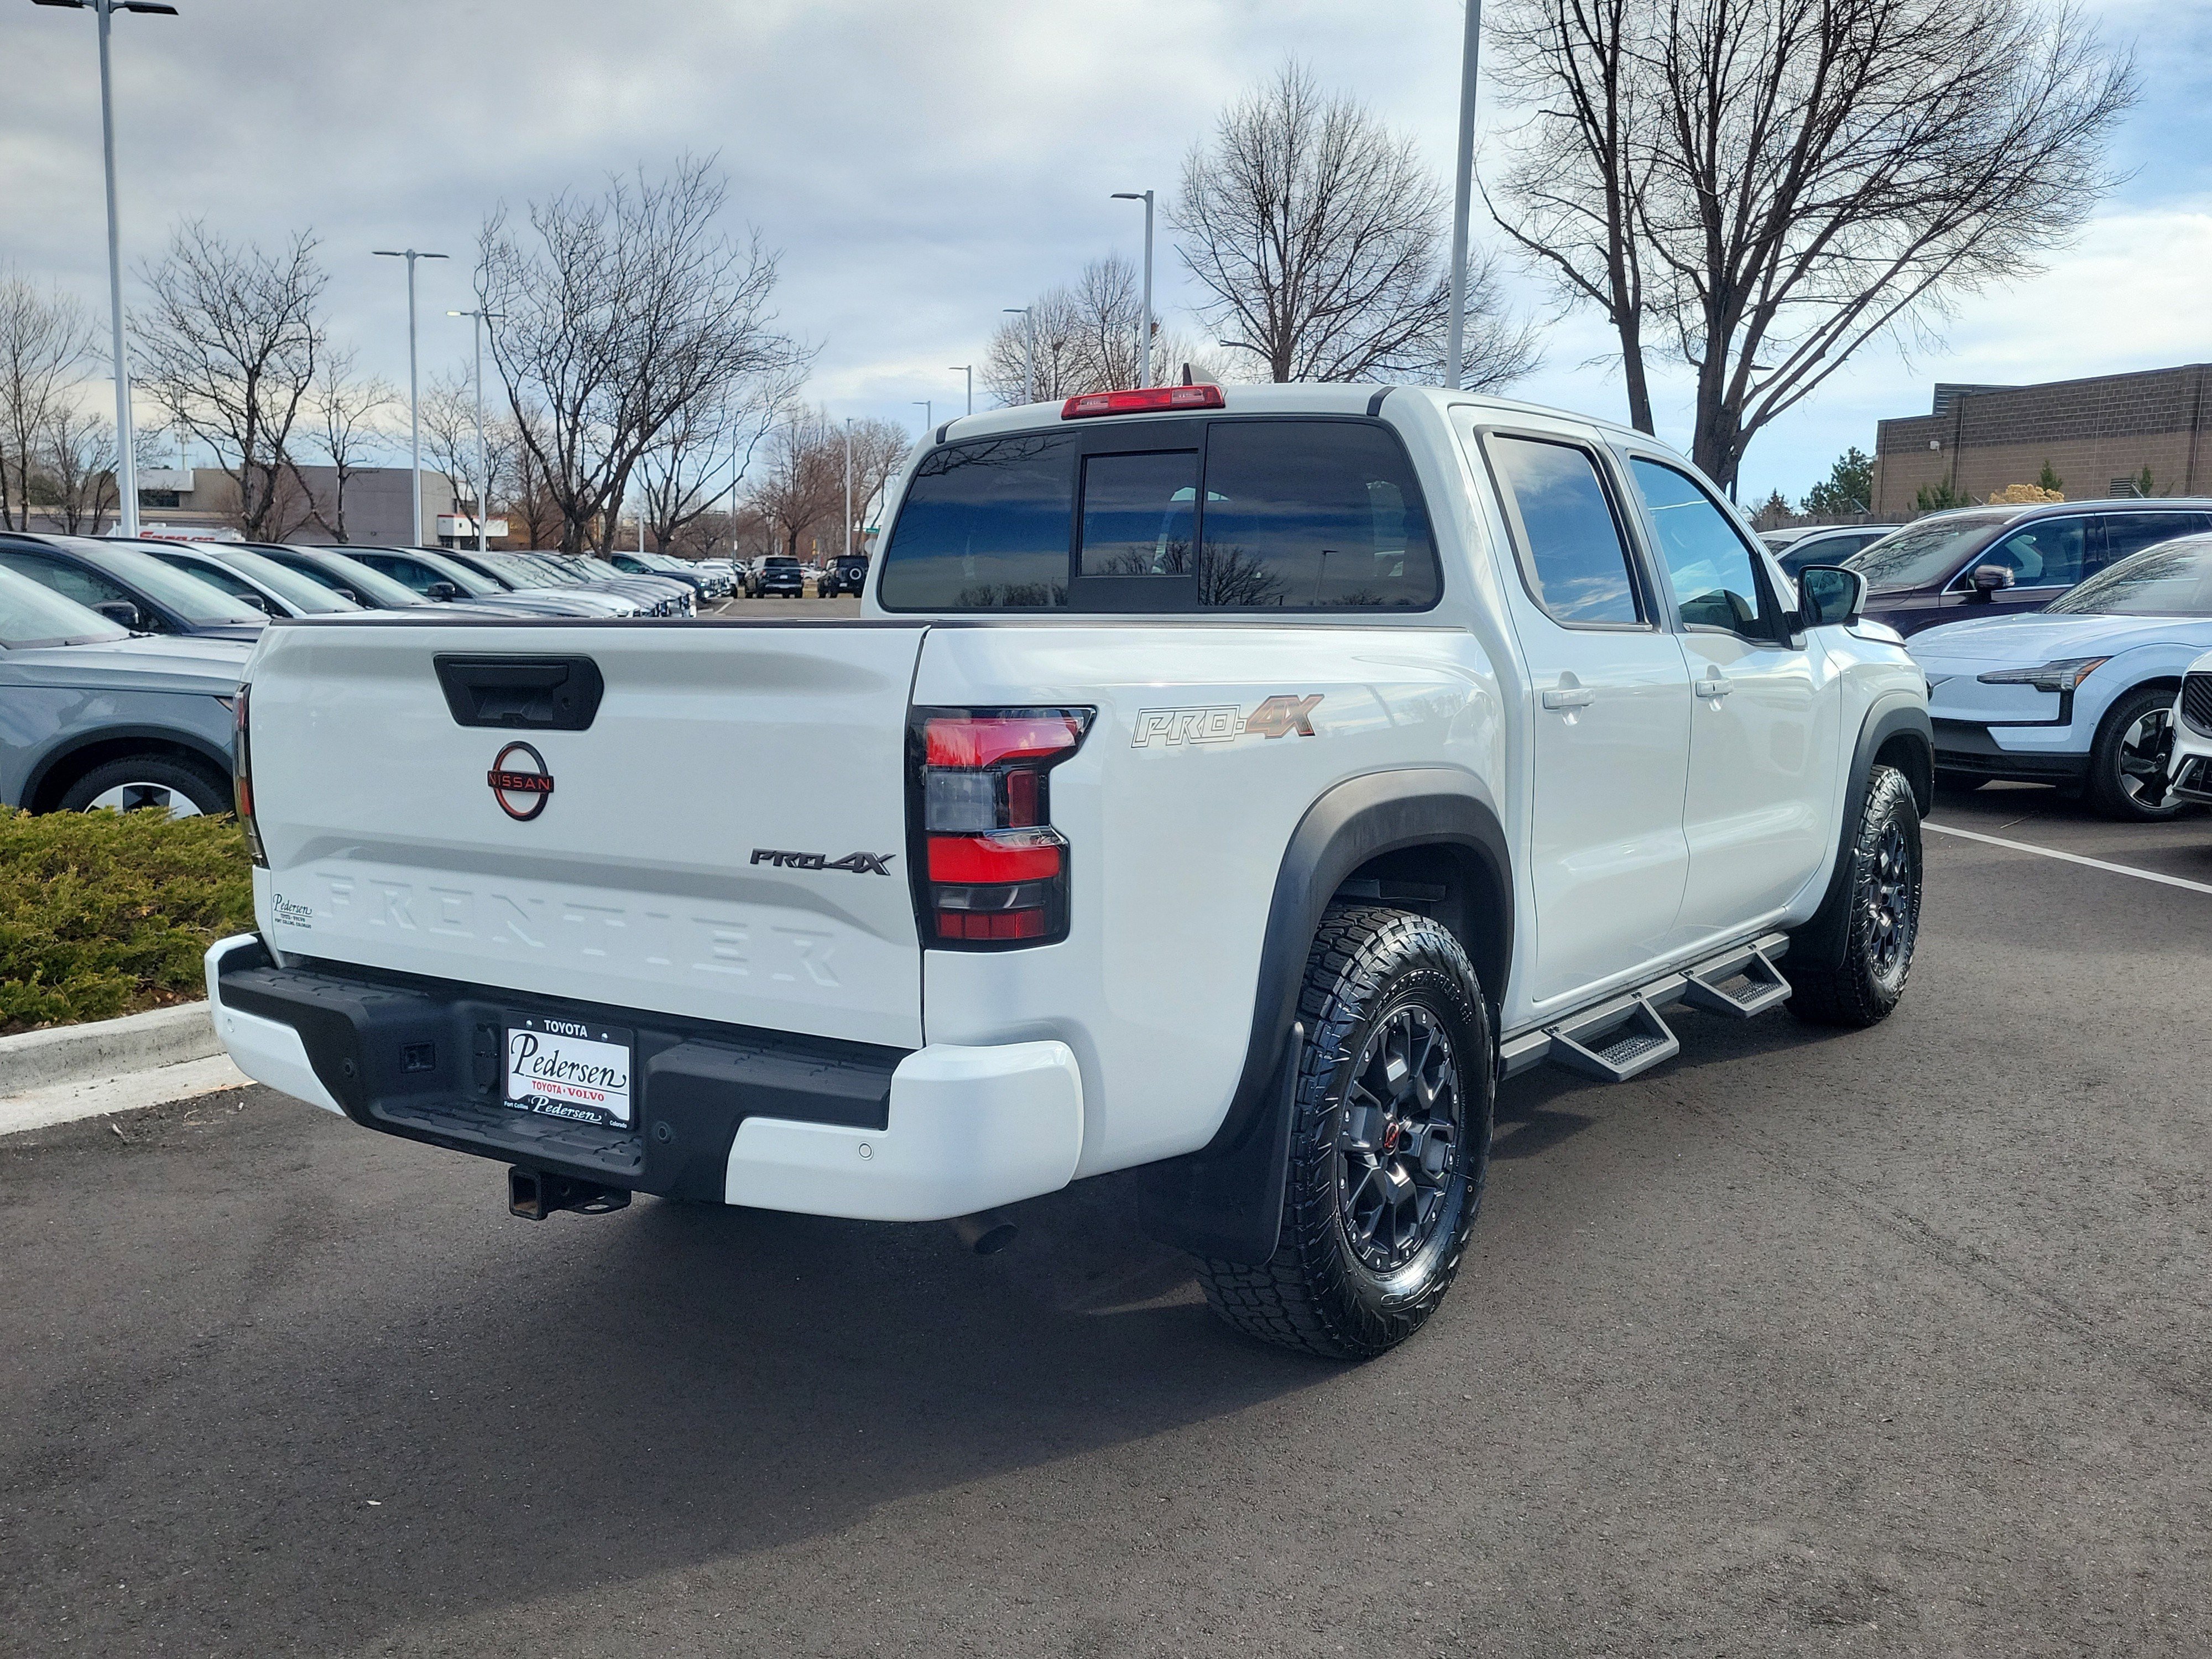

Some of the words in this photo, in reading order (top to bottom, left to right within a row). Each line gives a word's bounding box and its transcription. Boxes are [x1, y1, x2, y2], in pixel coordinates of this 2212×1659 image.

[1131, 693, 1324, 749] PRO-4X
[489, 773, 550, 790] NISSAN
[750, 848, 896, 876] PRO-4X
[273, 893, 312, 915] Pedersen
[315, 871, 841, 987] FRONTIER
[544, 1019, 588, 1037] TOYOTA
[510, 1033, 627, 1088] Pedersen
[532, 1080, 562, 1094] TOYOTA
[566, 1087, 604, 1102] VOLVO
[514, 1102, 529, 1110] Collins
[531, 1095, 602, 1121] Pedersen
[609, 1120, 628, 1129] Colorado
